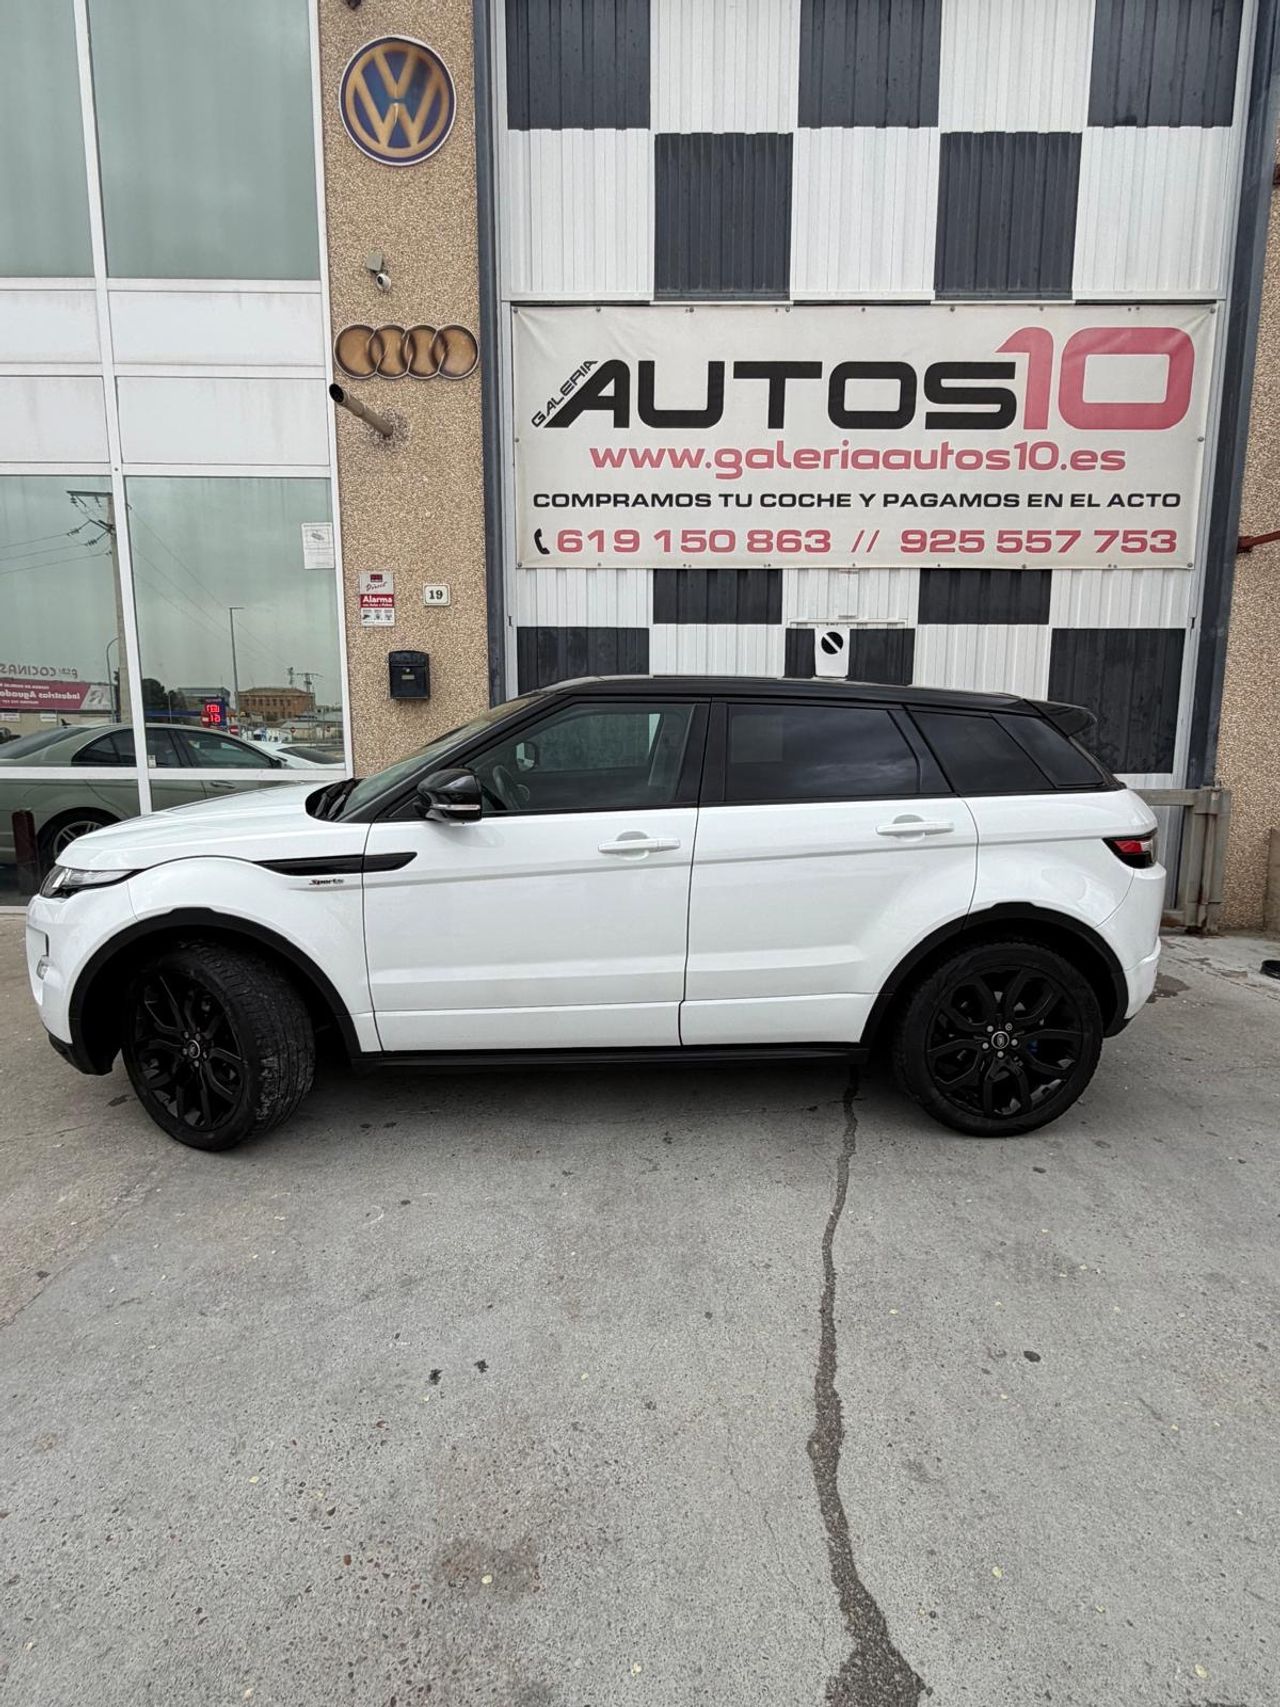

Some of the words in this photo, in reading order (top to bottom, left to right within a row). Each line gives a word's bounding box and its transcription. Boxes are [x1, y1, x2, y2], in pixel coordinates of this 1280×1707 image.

[531, 360, 598, 428] GALERIA
[591, 440, 1125, 479] www.galeriaautos10.es
[534, 494, 711, 507] COMPRAMOS
[719, 494, 752, 507] TU
[760, 494, 851, 507] COCHE
[860, 494, 875, 507] Y
[884, 494, 1019, 507] PAGAMOS
[1028, 494, 1063, 507] EN
[1071, 494, 1100, 507] EL
[1107, 494, 1180, 507] ACTO
[556, 529, 640, 553] 619
[656, 529, 735, 553] 150
[747, 529, 831, 554] 863
[851, 530, 880, 553] //
[900, 529, 986, 554] 925
[996, 529, 1081, 554] 557
[1095, 529, 1177, 554] 753
[362, 595, 392, 603] Alarma
[428, 589, 444, 600] 19
